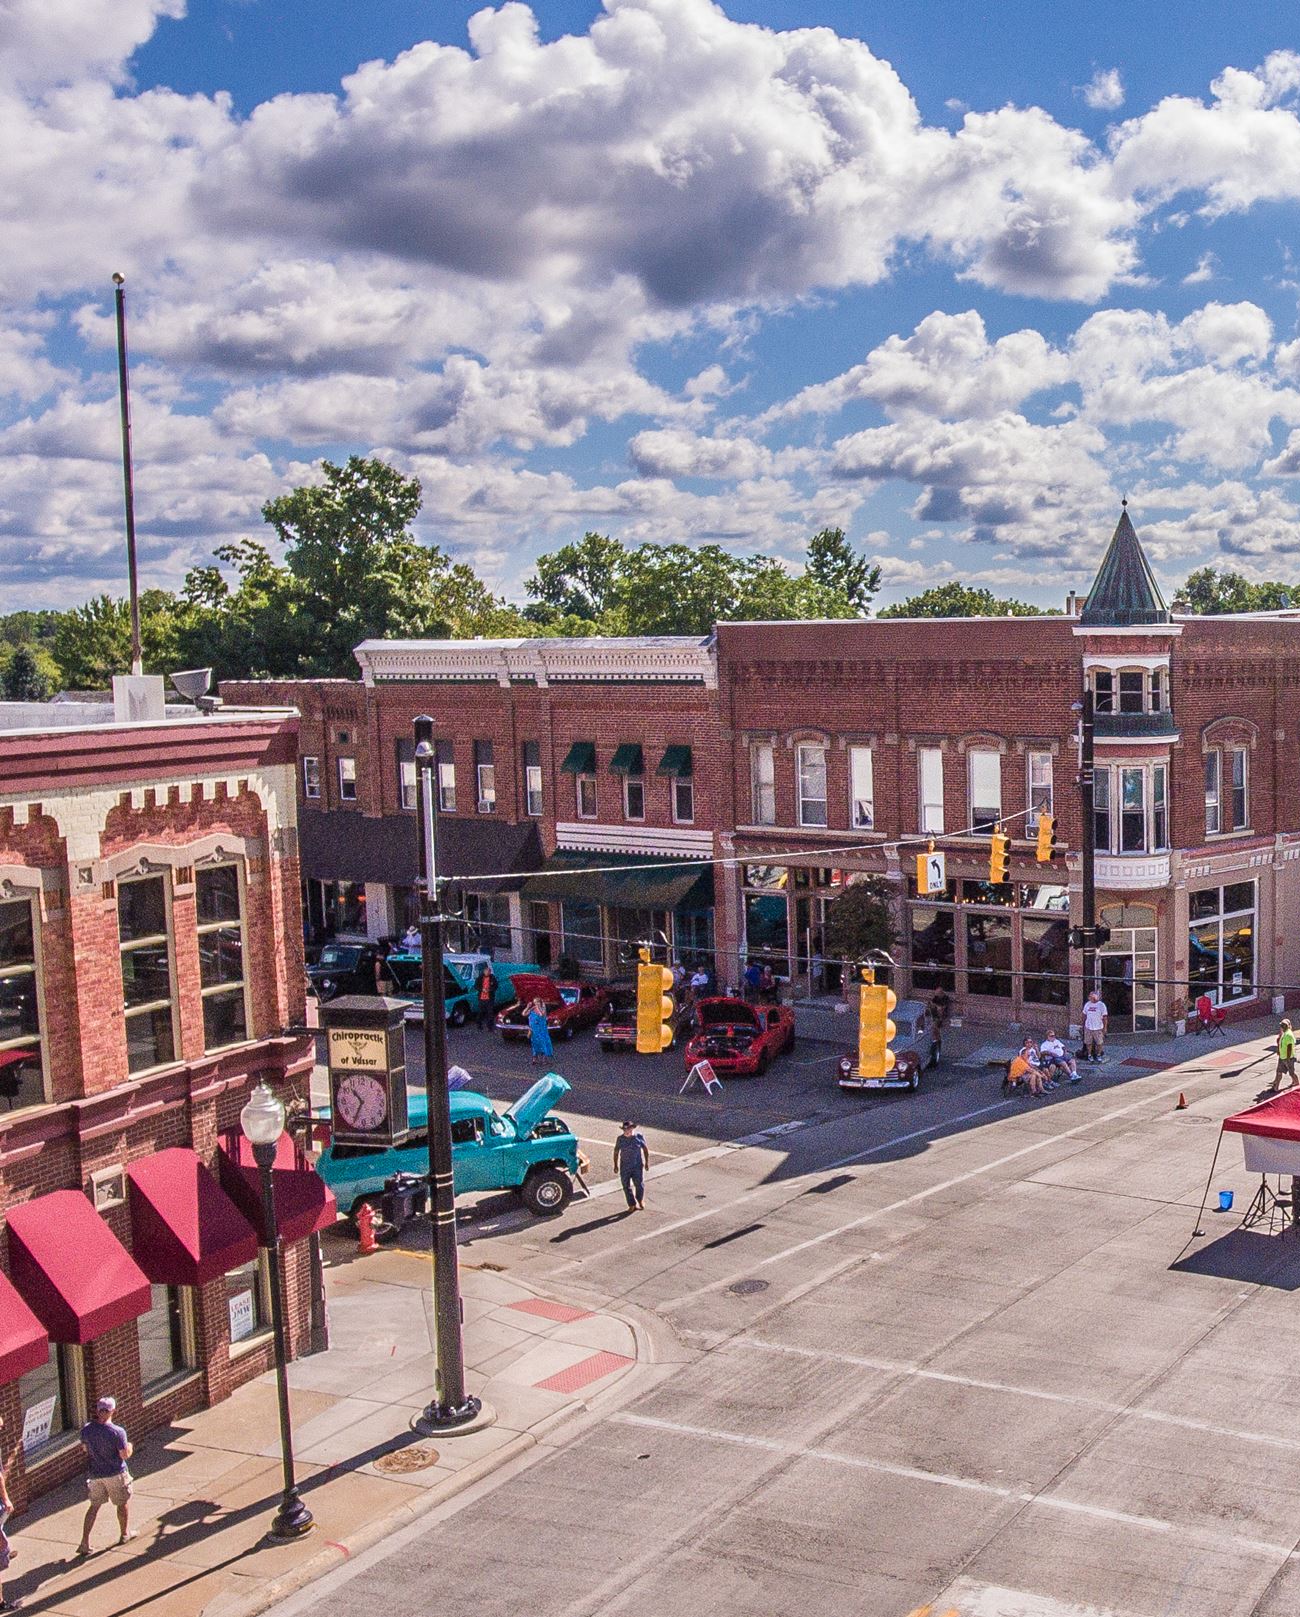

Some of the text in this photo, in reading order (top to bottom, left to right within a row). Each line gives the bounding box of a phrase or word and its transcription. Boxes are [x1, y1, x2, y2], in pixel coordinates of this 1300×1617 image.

[929, 881, 942, 890] ONLY
[332, 1031, 384, 1044] Chiropractic
[340, 1056, 377, 1066] of Vassar
